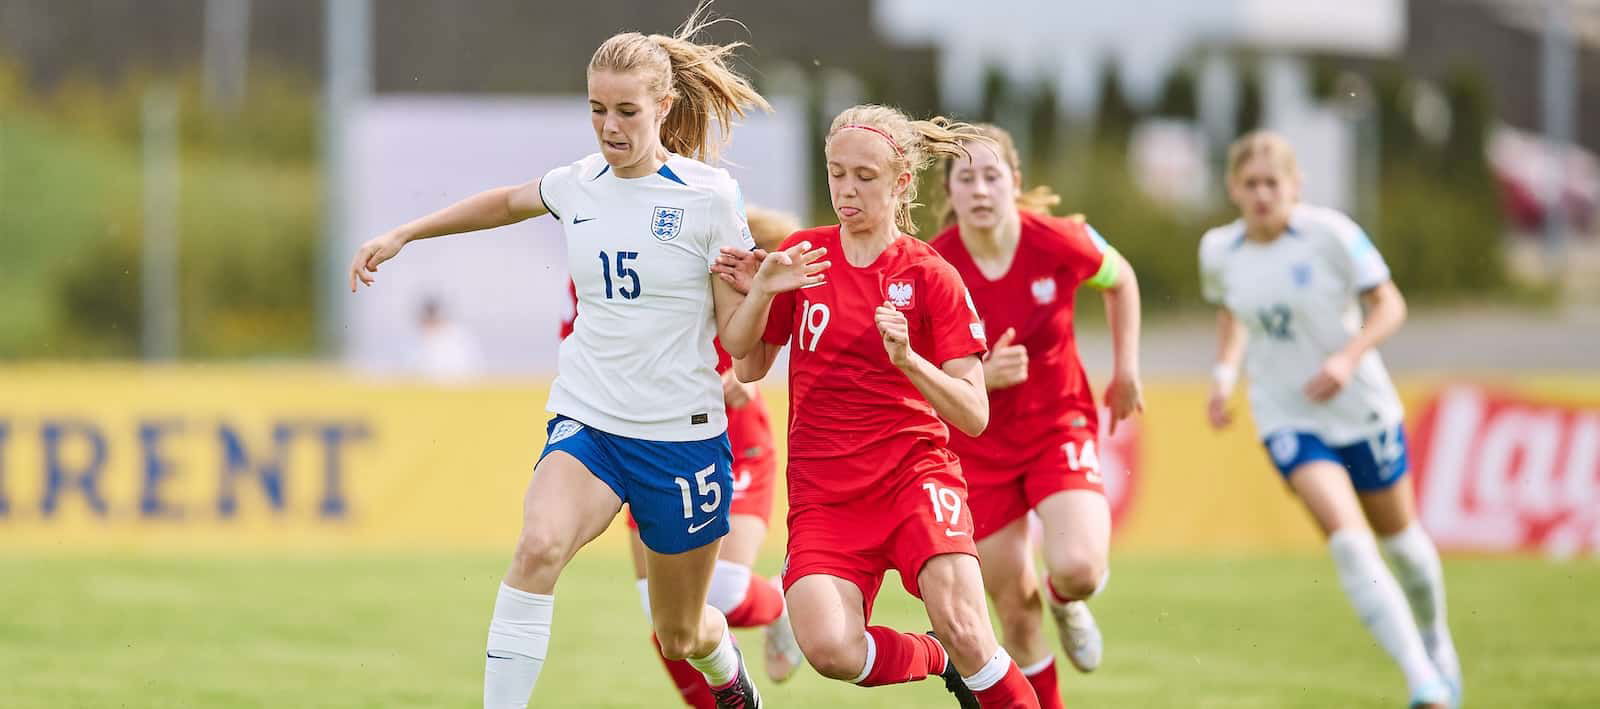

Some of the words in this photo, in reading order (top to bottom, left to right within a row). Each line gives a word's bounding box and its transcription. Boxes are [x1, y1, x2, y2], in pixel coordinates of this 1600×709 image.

[599, 251, 641, 300] 15
[799, 299, 831, 352] 19
[0, 416, 374, 519] RENT
[1060, 438, 1101, 475] 14
[674, 463, 722, 519] 15
[922, 482, 962, 525] 19
